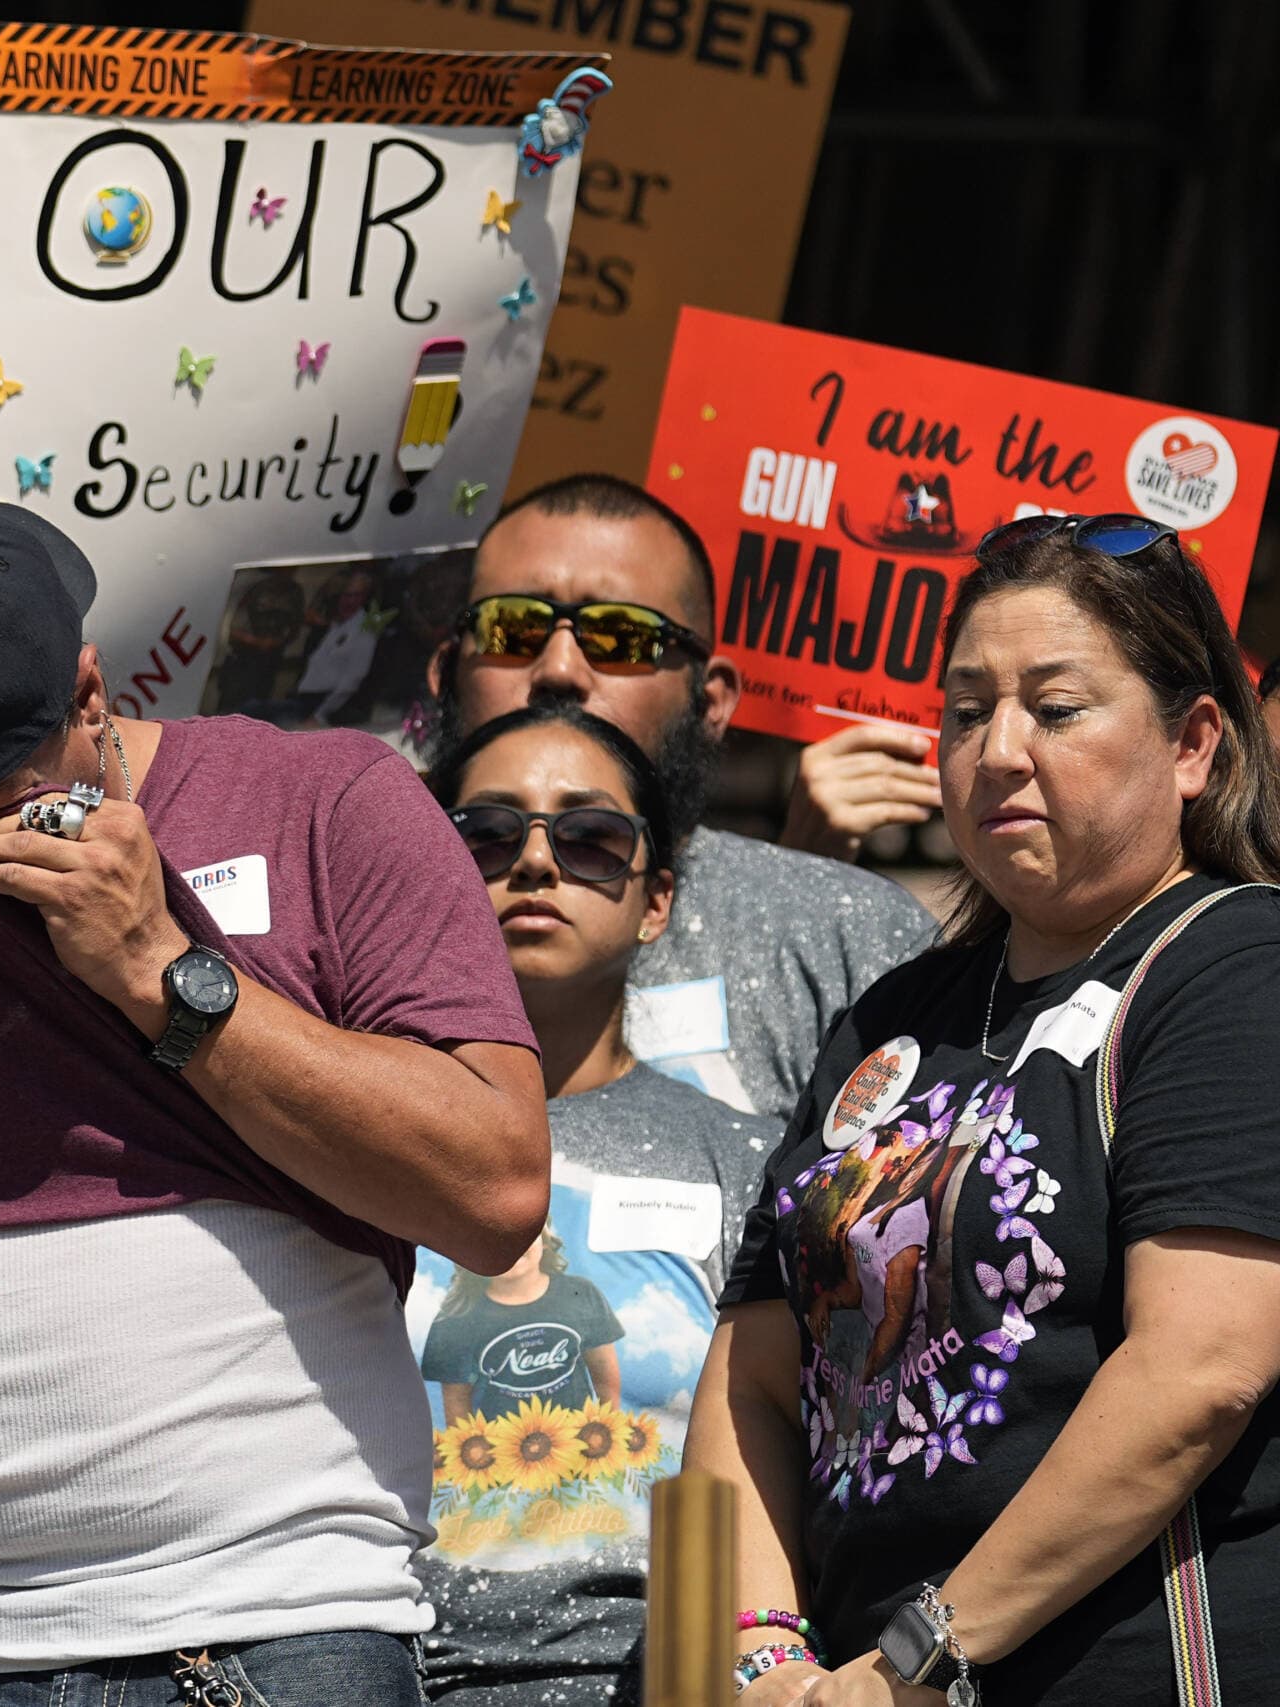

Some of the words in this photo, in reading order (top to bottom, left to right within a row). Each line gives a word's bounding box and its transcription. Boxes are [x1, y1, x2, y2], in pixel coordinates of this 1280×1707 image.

[130, 57, 209, 97] ZONE
[290, 66, 435, 105] LEARNING
[442, 70, 521, 107] ZONE
[36, 128, 448, 323] OUR
[810, 371, 846, 447] I
[867, 408, 973, 467] am
[993, 414, 1097, 494] the
[740, 447, 837, 529] GUN
[723, 531, 948, 690] MAJO
[184, 865, 237, 890] ORDS
[1070, 1001, 1097, 1018] Mata
[867, 1056, 903, 1081] Teachers
[812, 1341, 847, 1398] Tess
[848, 1374, 894, 1409] Marie
[899, 1326, 965, 1394] Mata
